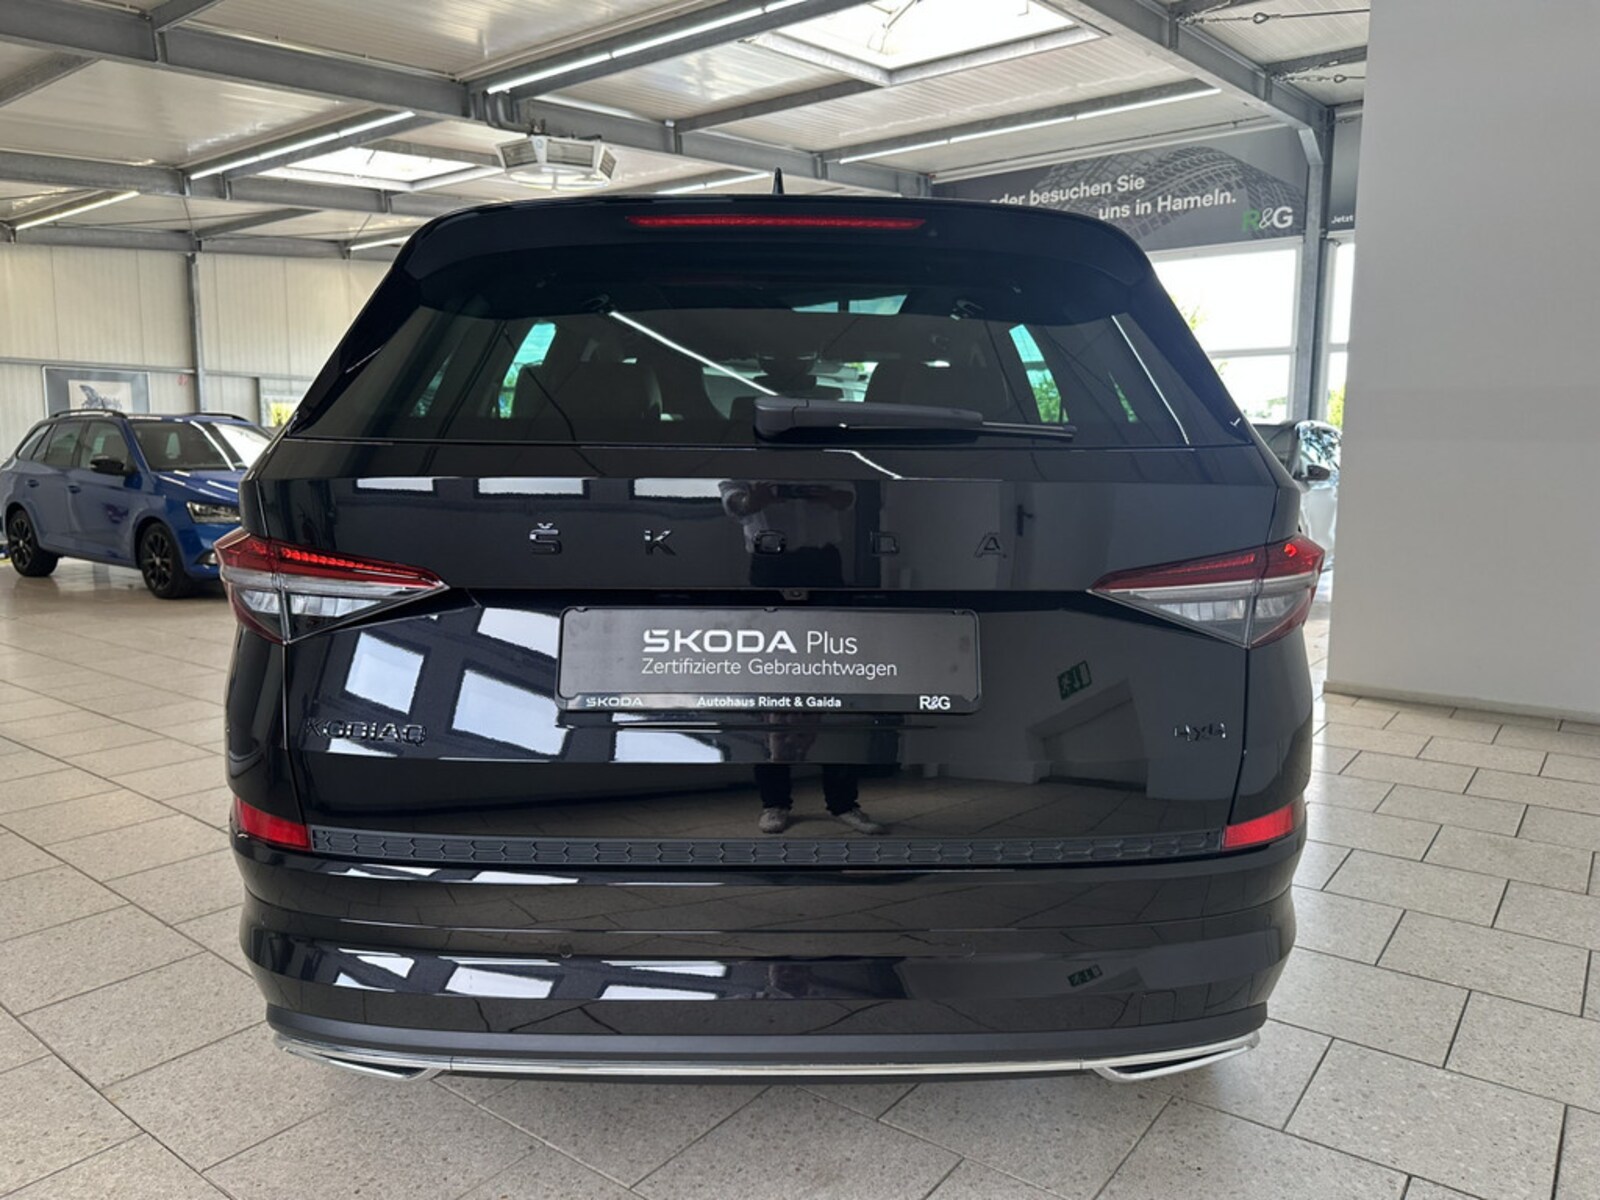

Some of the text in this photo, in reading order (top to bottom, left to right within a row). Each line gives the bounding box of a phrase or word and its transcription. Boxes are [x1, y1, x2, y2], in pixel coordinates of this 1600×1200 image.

[1029, 182, 1112, 206] besuchen
[1116, 174, 1145, 192] Sie
[1098, 188, 1237, 220] uns in Hameln.
[1242, 206, 1294, 232] R&G
[1330, 214, 1354, 224] Jetzt
[806, 630, 858, 655] Plus
[641, 657, 898, 681] Zertifizierte Gebrauchtwagen
[696, 696, 842, 708] Autohaus Rindt & Gaida
[305, 716, 427, 747] KODIAQ
